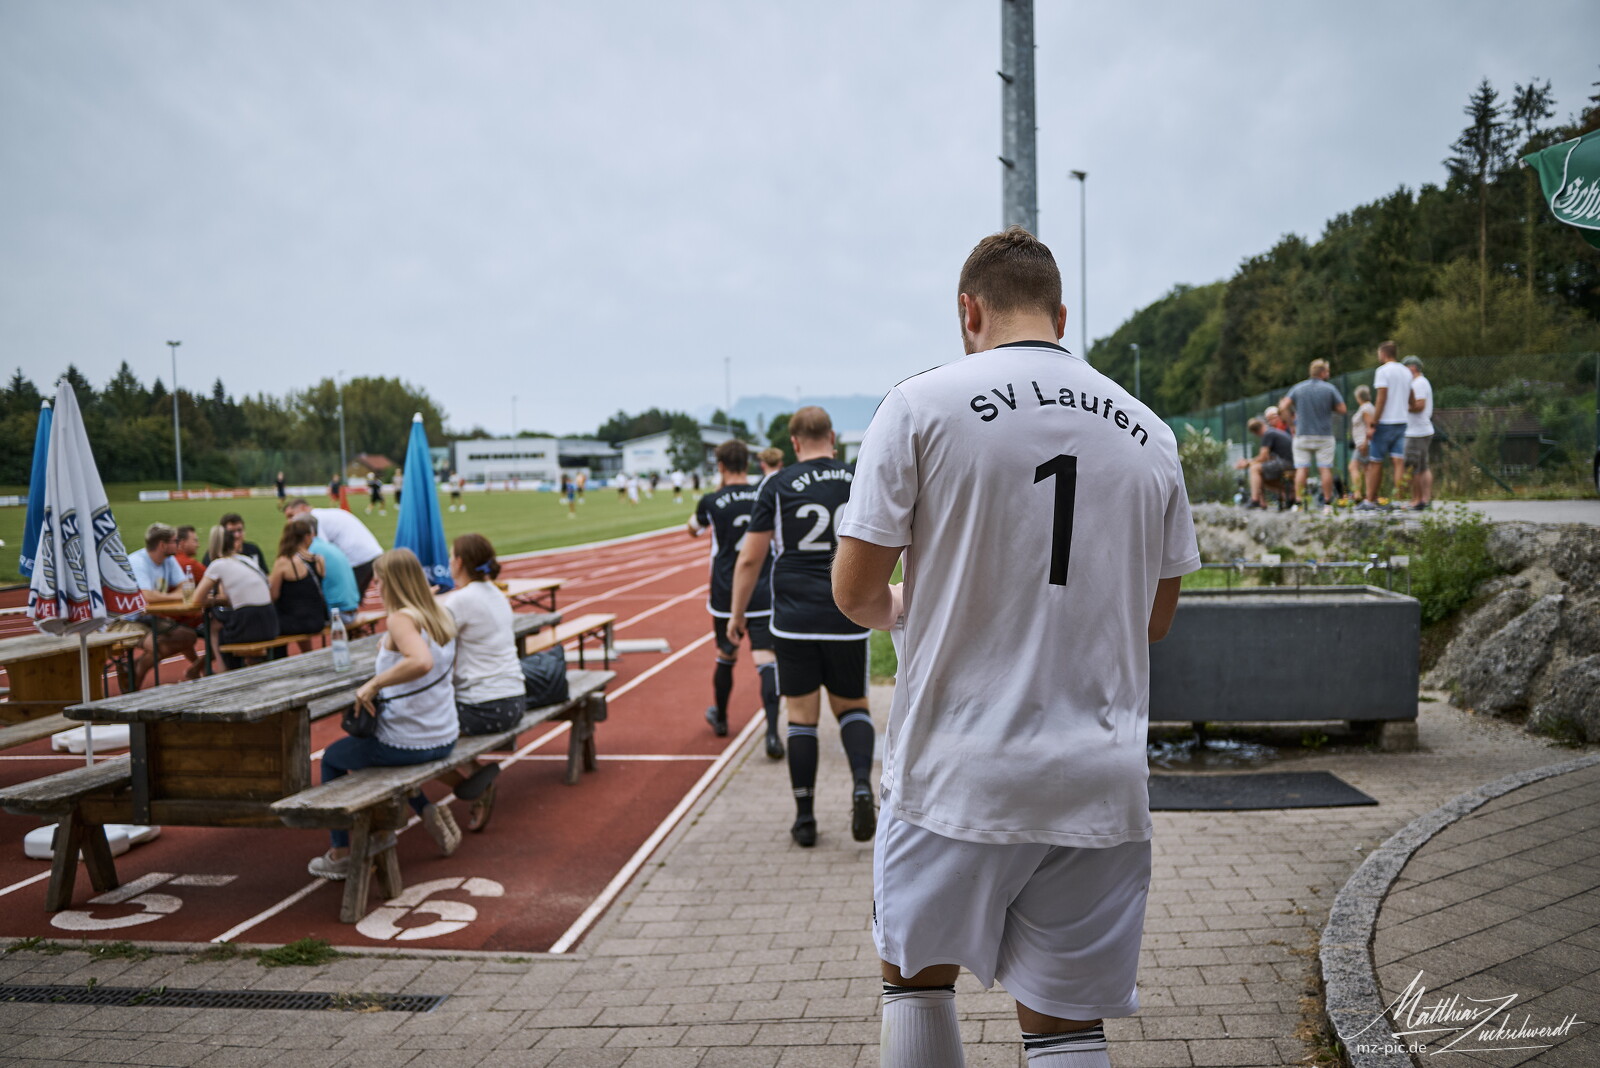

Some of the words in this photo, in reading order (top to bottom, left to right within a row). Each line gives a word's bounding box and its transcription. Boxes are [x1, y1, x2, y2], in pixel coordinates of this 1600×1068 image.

[970, 383, 1018, 423] SV
[1031, 381, 1149, 447] Laufen
[715, 493, 731, 509] SV
[791, 472, 811, 492] SV
[1033, 454, 1078, 586] 1
[50, 872, 238, 932] 5
[355, 876, 505, 942] 6
